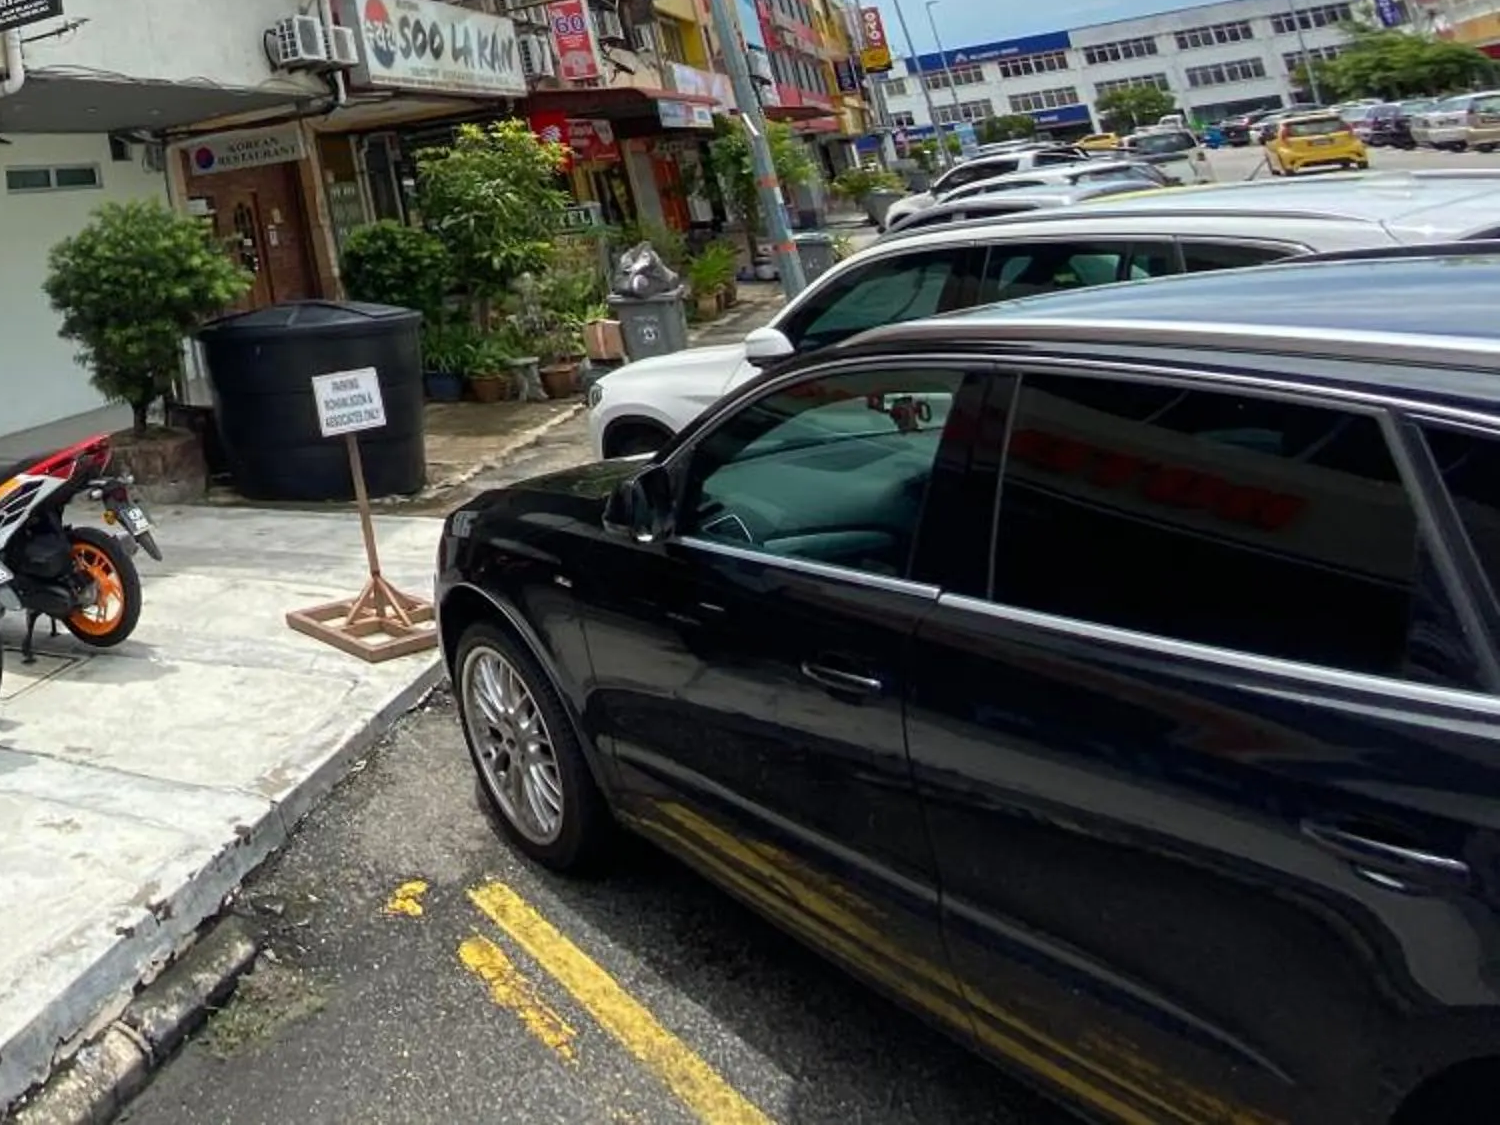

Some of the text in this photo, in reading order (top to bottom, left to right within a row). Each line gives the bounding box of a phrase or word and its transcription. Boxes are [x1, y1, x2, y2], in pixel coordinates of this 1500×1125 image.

[399, 11, 515, 75] SOO LA KAN
[217, 145, 297, 166] RESTAURANT
[229, 137, 279, 153] KOREAN
